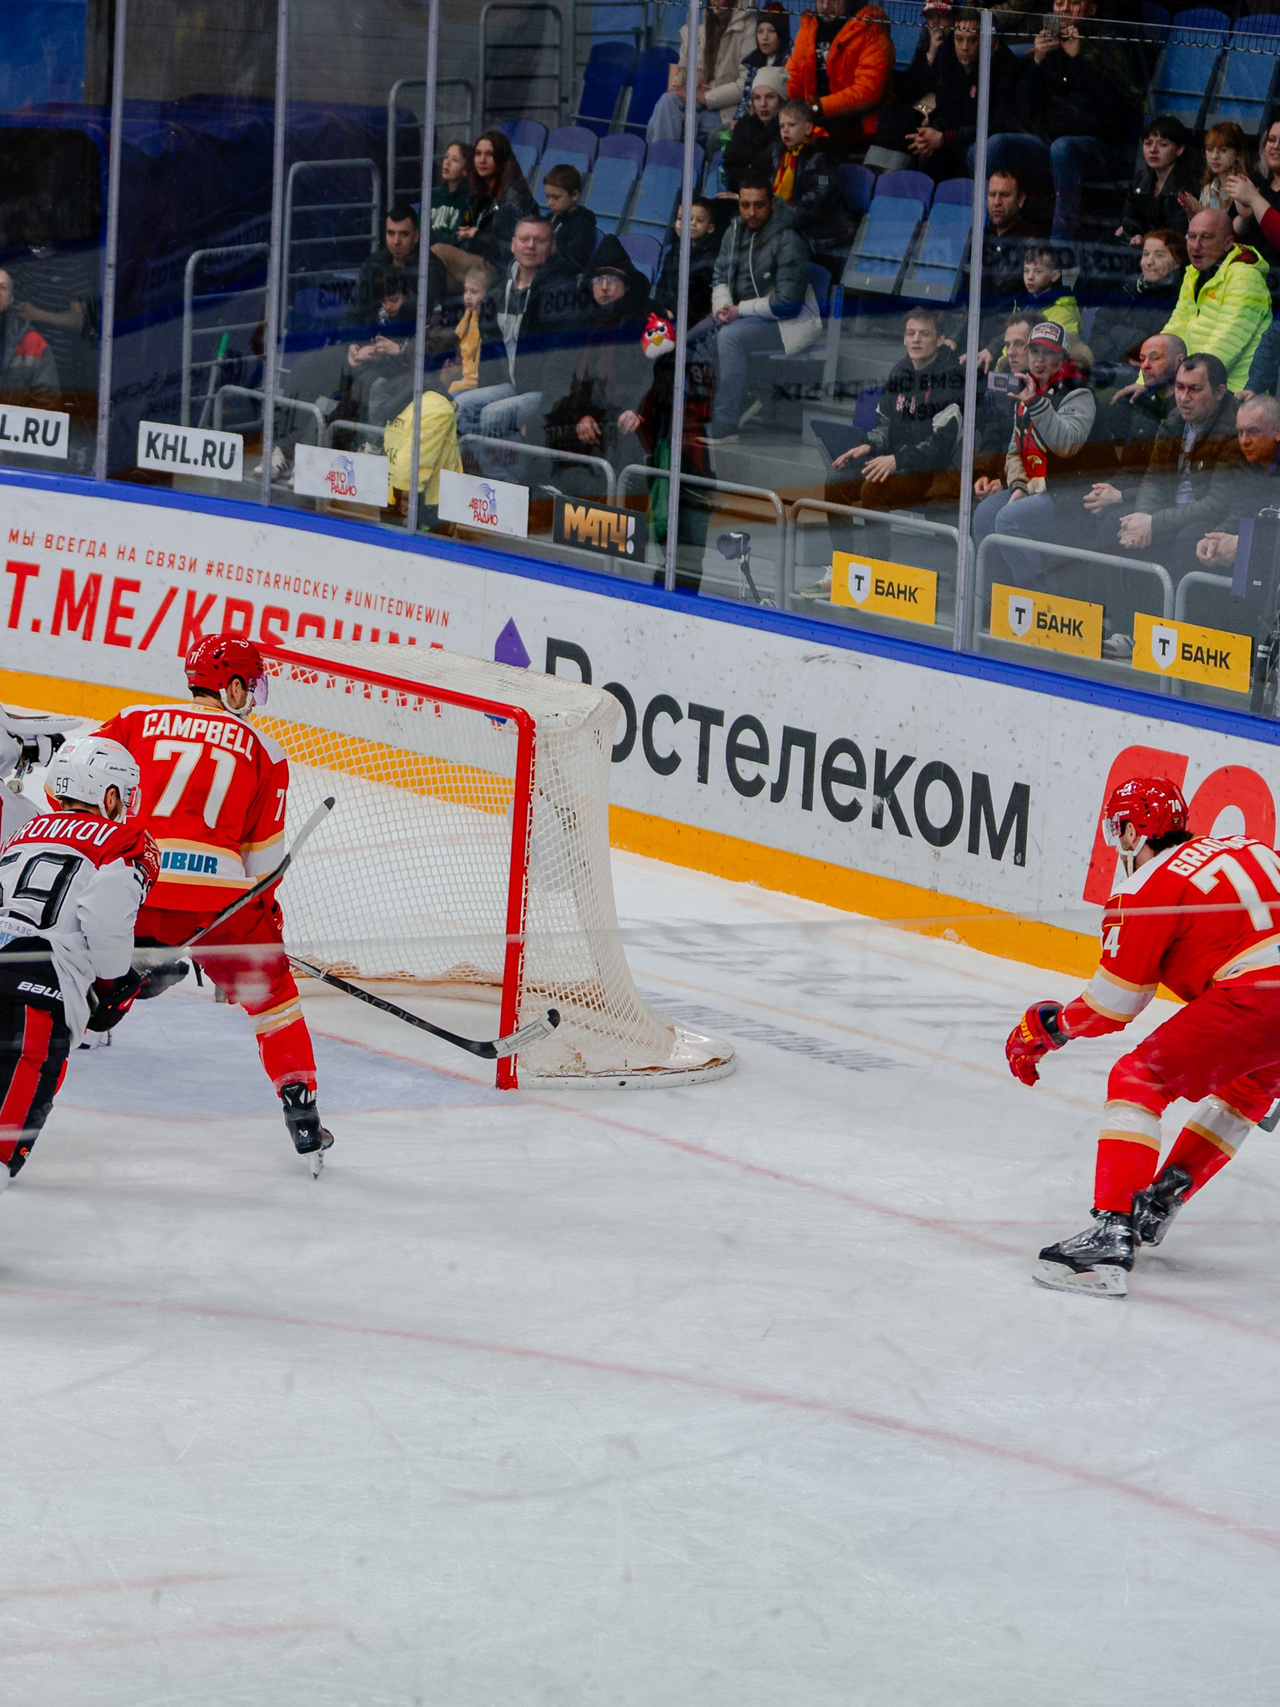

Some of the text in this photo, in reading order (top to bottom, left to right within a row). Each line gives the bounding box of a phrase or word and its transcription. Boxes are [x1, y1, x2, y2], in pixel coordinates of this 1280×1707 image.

[145, 430, 237, 470] KHL.RU
[8, 528, 198, 573] МЫ ВСЕГДА НА СВЯЗИ
[205, 560, 450, 628] #REDSTARHOCKEY #UNITEDWEWIN
[874, 578, 919, 604] БАНК
[1037, 611, 1084, 639] БАНК
[1181, 643, 1231, 670] БАНК
[142, 711, 254, 761] CAMPBELL
[55, 777, 69, 794] 59
[152, 739, 237, 829] 71
[274, 788, 286, 822] 7
[1168, 799, 1182, 813] 74
[0, 817, 118, 854] RONKOV
[160, 850, 218, 875] IBUR
[1167, 834, 1261, 877] GRAOAC
[1103, 926, 1121, 958] 4
[17, 981, 64, 1002] BAUE
[346, 984, 420, 1027] VAPOR
